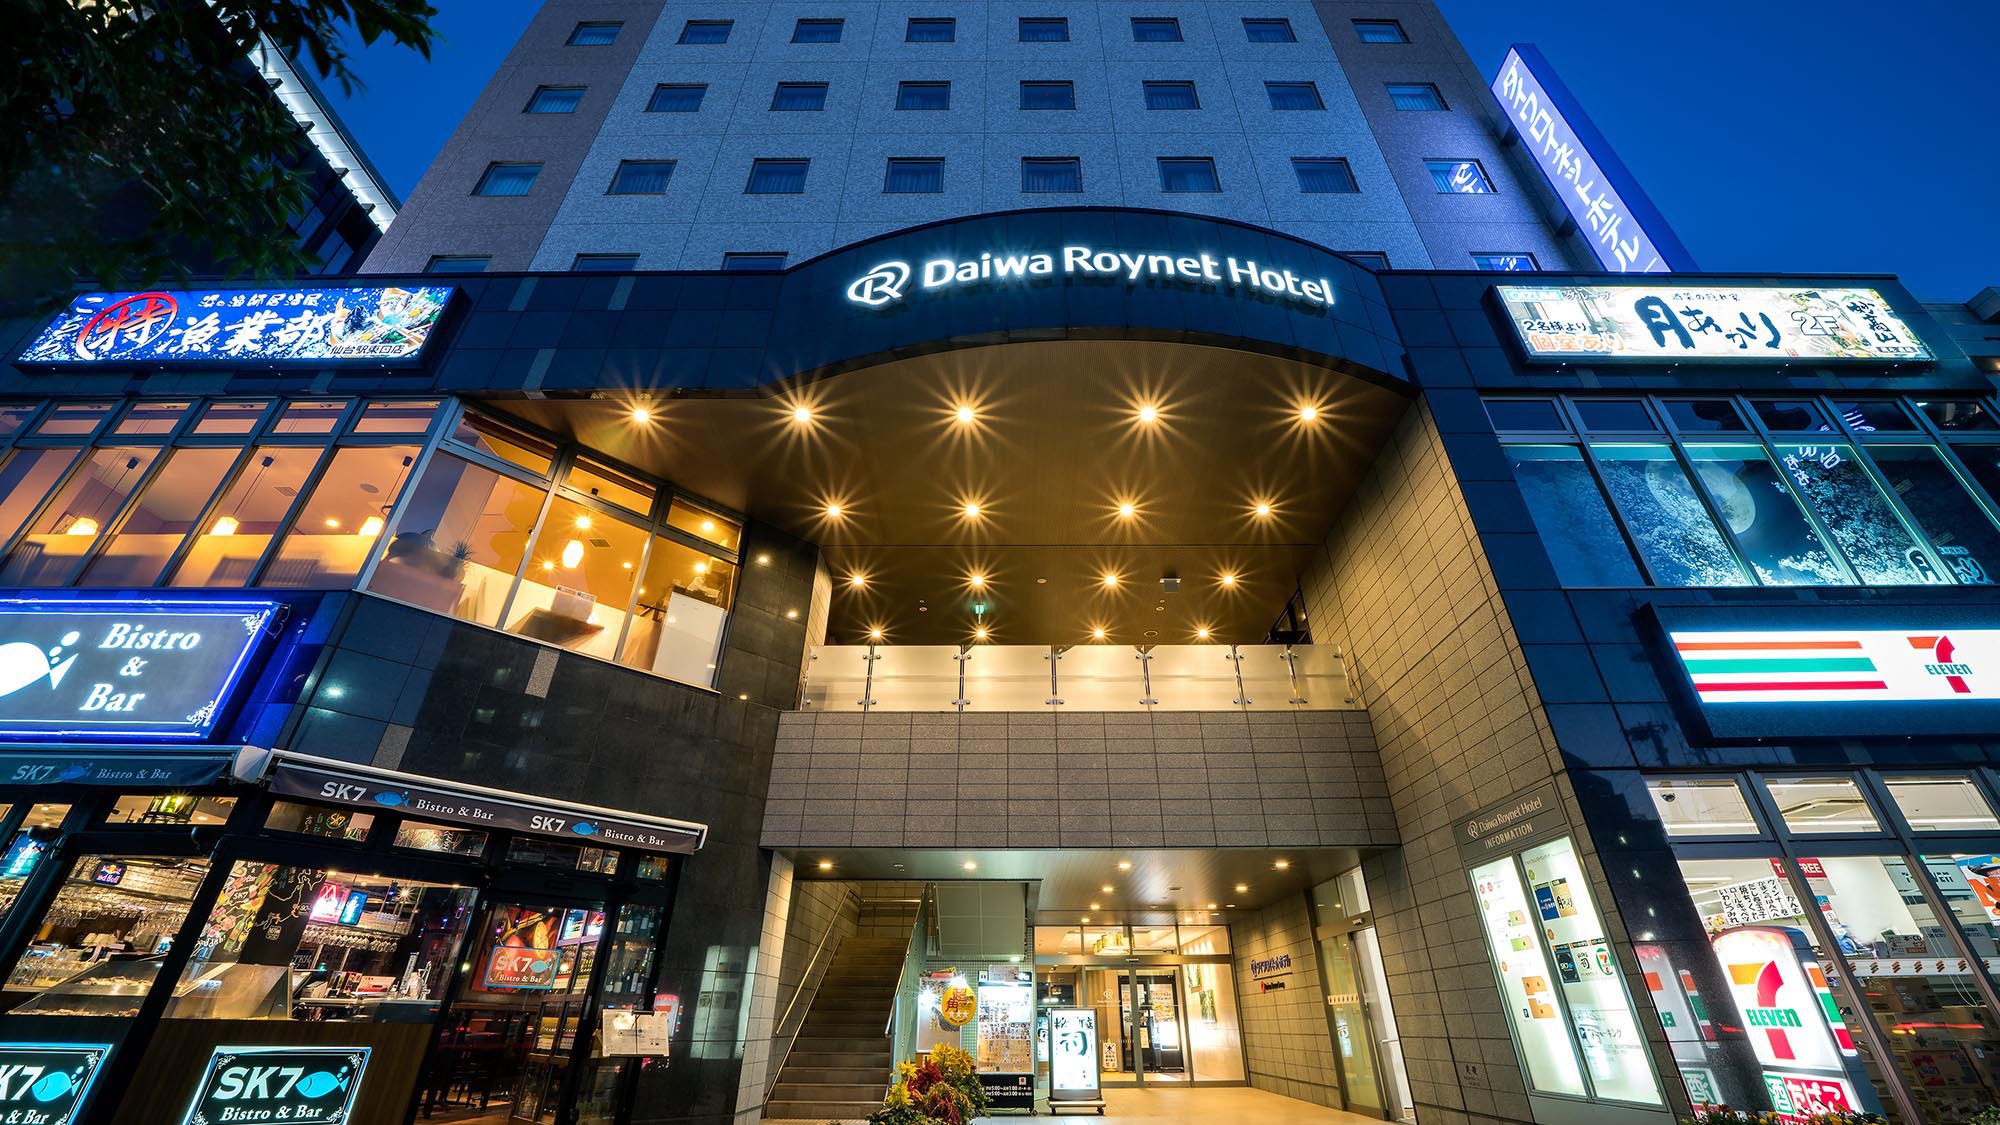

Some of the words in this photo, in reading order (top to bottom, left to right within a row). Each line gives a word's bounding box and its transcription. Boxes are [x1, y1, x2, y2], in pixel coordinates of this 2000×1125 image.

[924, 251, 1052, 288] Daiwa
[1064, 247, 1221, 280] Roynet
[1226, 258, 1335, 305] Hotel
[1523, 320, 1587, 332] 2名様より
[1634, 296, 1782, 350] 月あかり
[1791, 311, 1839, 336] 2F
[330, 345, 405, 355] 仙台駅東口店
[1530, 334, 1625, 351] 個室あり
[98, 623, 201, 650] Bistro
[120, 656, 148, 677] &
[79, 683, 146, 712] Bar
[11, 765, 56, 780] SK7
[97, 768, 133, 779] Bistro
[137, 769, 147, 779] &
[151, 769, 172, 779] Bar
[320, 781, 367, 802] SK7
[416, 799, 454, 814] Bistro
[458, 807, 470, 816] &
[473, 808, 494, 820] Bar
[1478, 818, 1499, 833] Daiwa
[1496, 806, 1522, 824] Roynet
[1520, 796, 1543, 815] Hotel
[530, 815, 566, 833] SK7
[604, 828, 634, 842] Bistro
[637, 834, 646, 843] &
[649, 835, 665, 846] Bar
[1484, 823, 1534, 849] INFORMATION
[495, 955, 533, 972] SK7
[499, 974, 520, 982] Bistro
[530, 975, 543, 983] Bar
[0, 1065, 45, 1101] K7
[212, 1066, 304, 1100] SK7
[5, 1109, 22, 1124] &
[21, 1109, 50, 1124] Bar
[219, 1107, 273, 1122] Bistro
[275, 1106, 294, 1120] &
[295, 1105, 323, 1119] Bar
